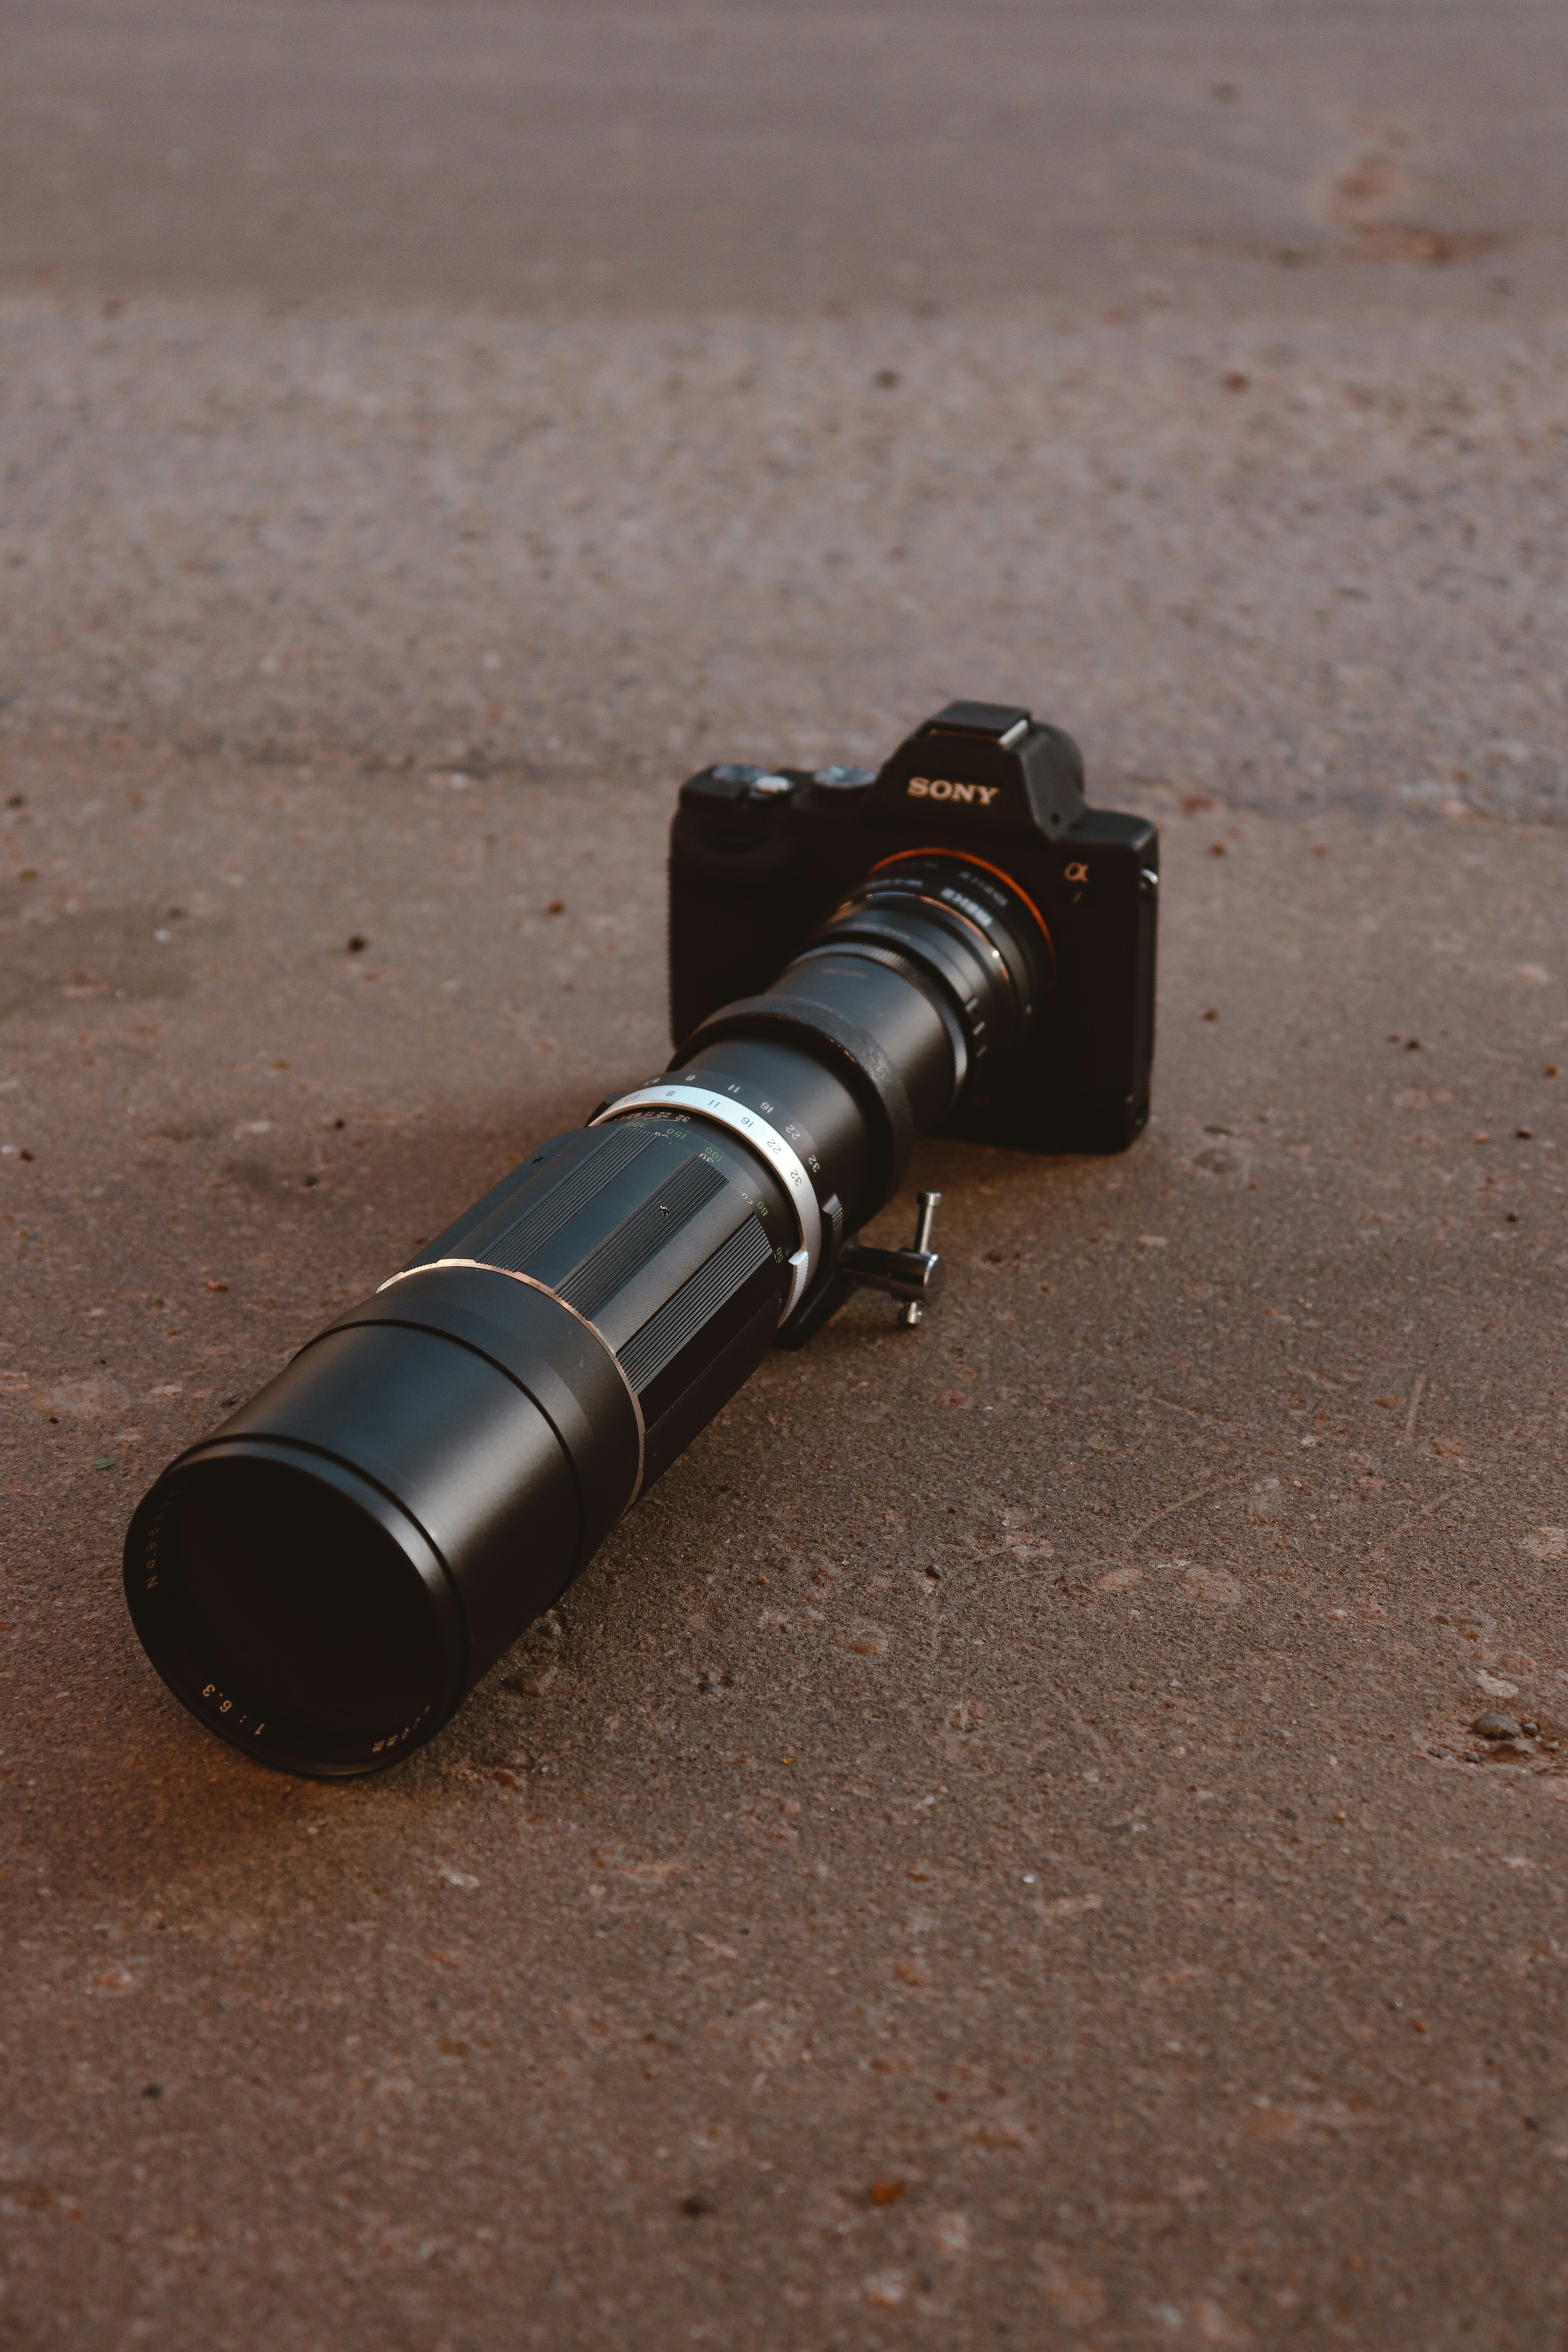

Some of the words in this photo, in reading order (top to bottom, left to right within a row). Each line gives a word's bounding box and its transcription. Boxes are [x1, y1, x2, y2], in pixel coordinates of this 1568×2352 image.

[907, 776, 1000, 806] SONY
[1071, 890, 1082, 904] 7
[728, 1084, 740, 1093] 11
[708, 1100, 720, 1108] 11
[760, 1102, 775, 1114] 16
[741, 1117, 753, 1128] 16
[666, 1128, 687, 1140] 150
[785, 1124, 800, 1140] 22
[704, 1146, 723, 1162] 100
[767, 1138, 782, 1154] 22
[808, 1154, 820, 1173] 32
[790, 1169, 802, 1187] 32
[757, 1200, 768, 1216] 60
[776, 1246, 784, 1263] 50
